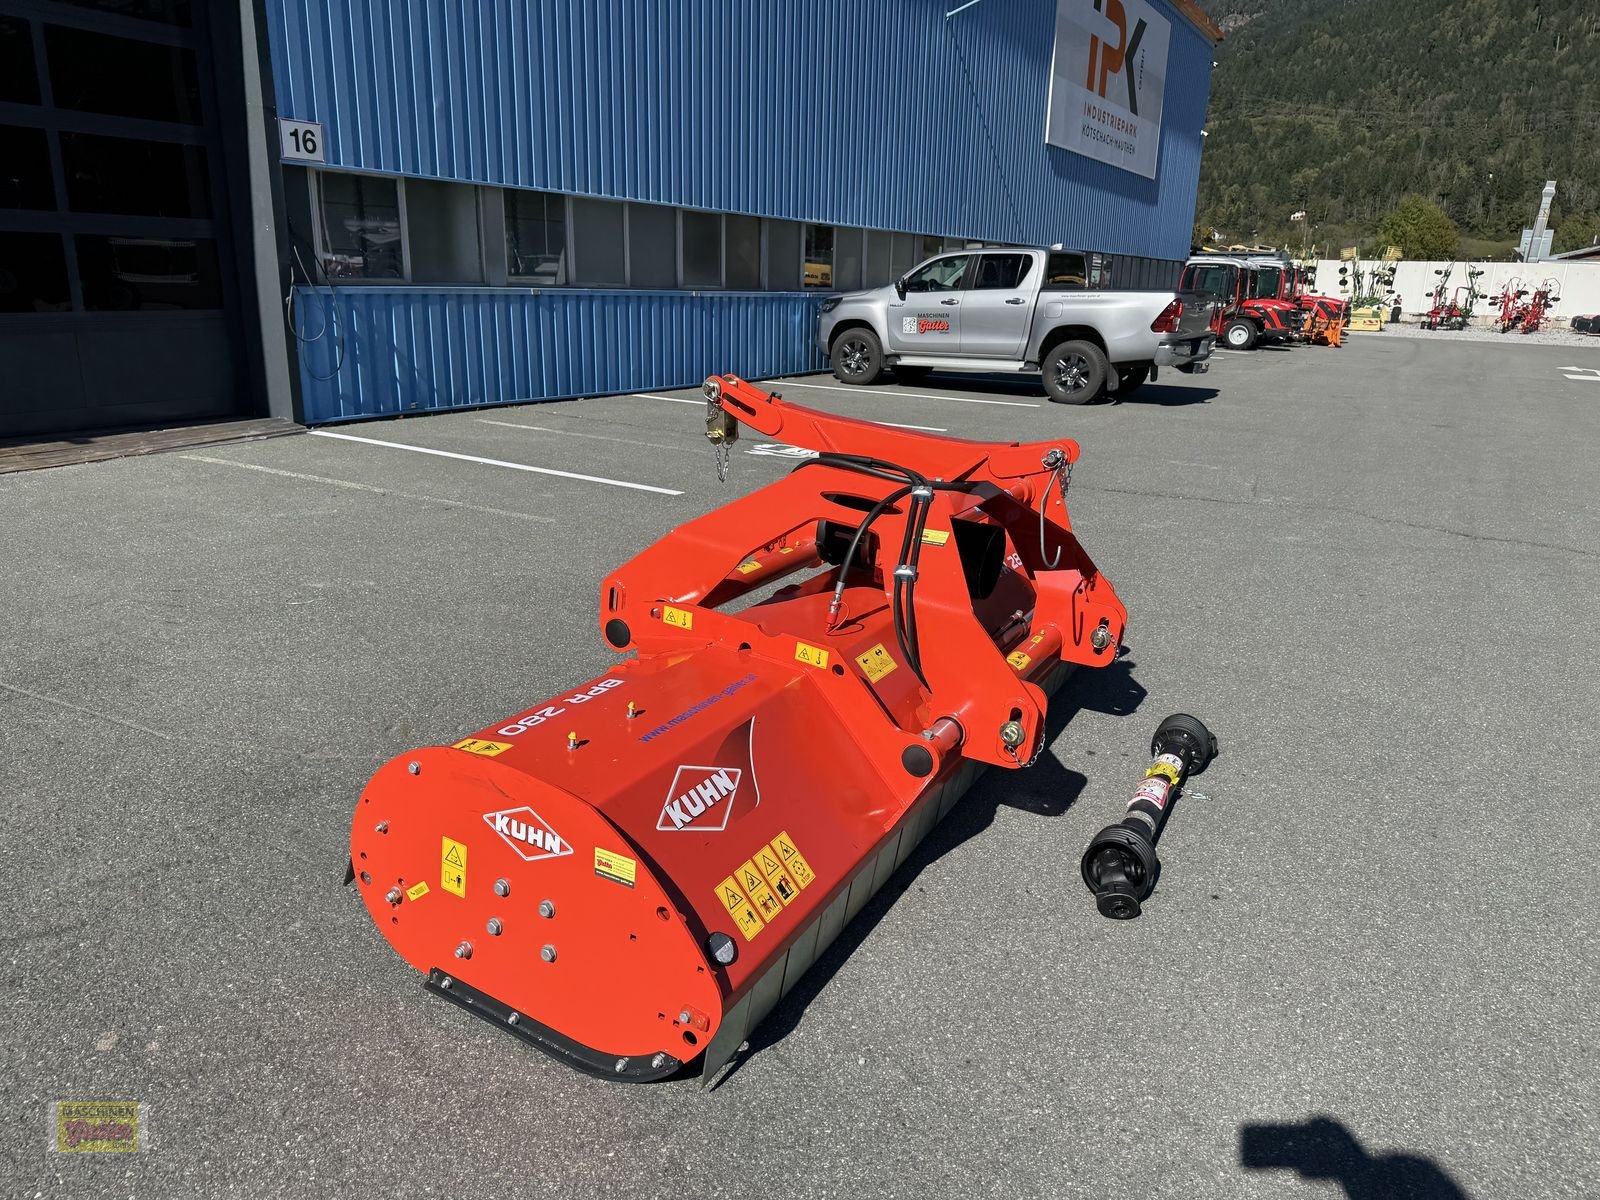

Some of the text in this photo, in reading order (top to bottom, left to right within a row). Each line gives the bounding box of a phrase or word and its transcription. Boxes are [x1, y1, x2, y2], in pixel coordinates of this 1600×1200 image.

[1084, 101, 1137, 138] INDUSTRIEPARK
[289, 128, 317, 154] 16
[917, 319, 950, 334] Gailer
[1006, 552, 1024, 570] 28
[496, 679, 625, 736] BPR 280
[664, 768, 736, 830] KUHN
[495, 812, 561, 855] KUHN
